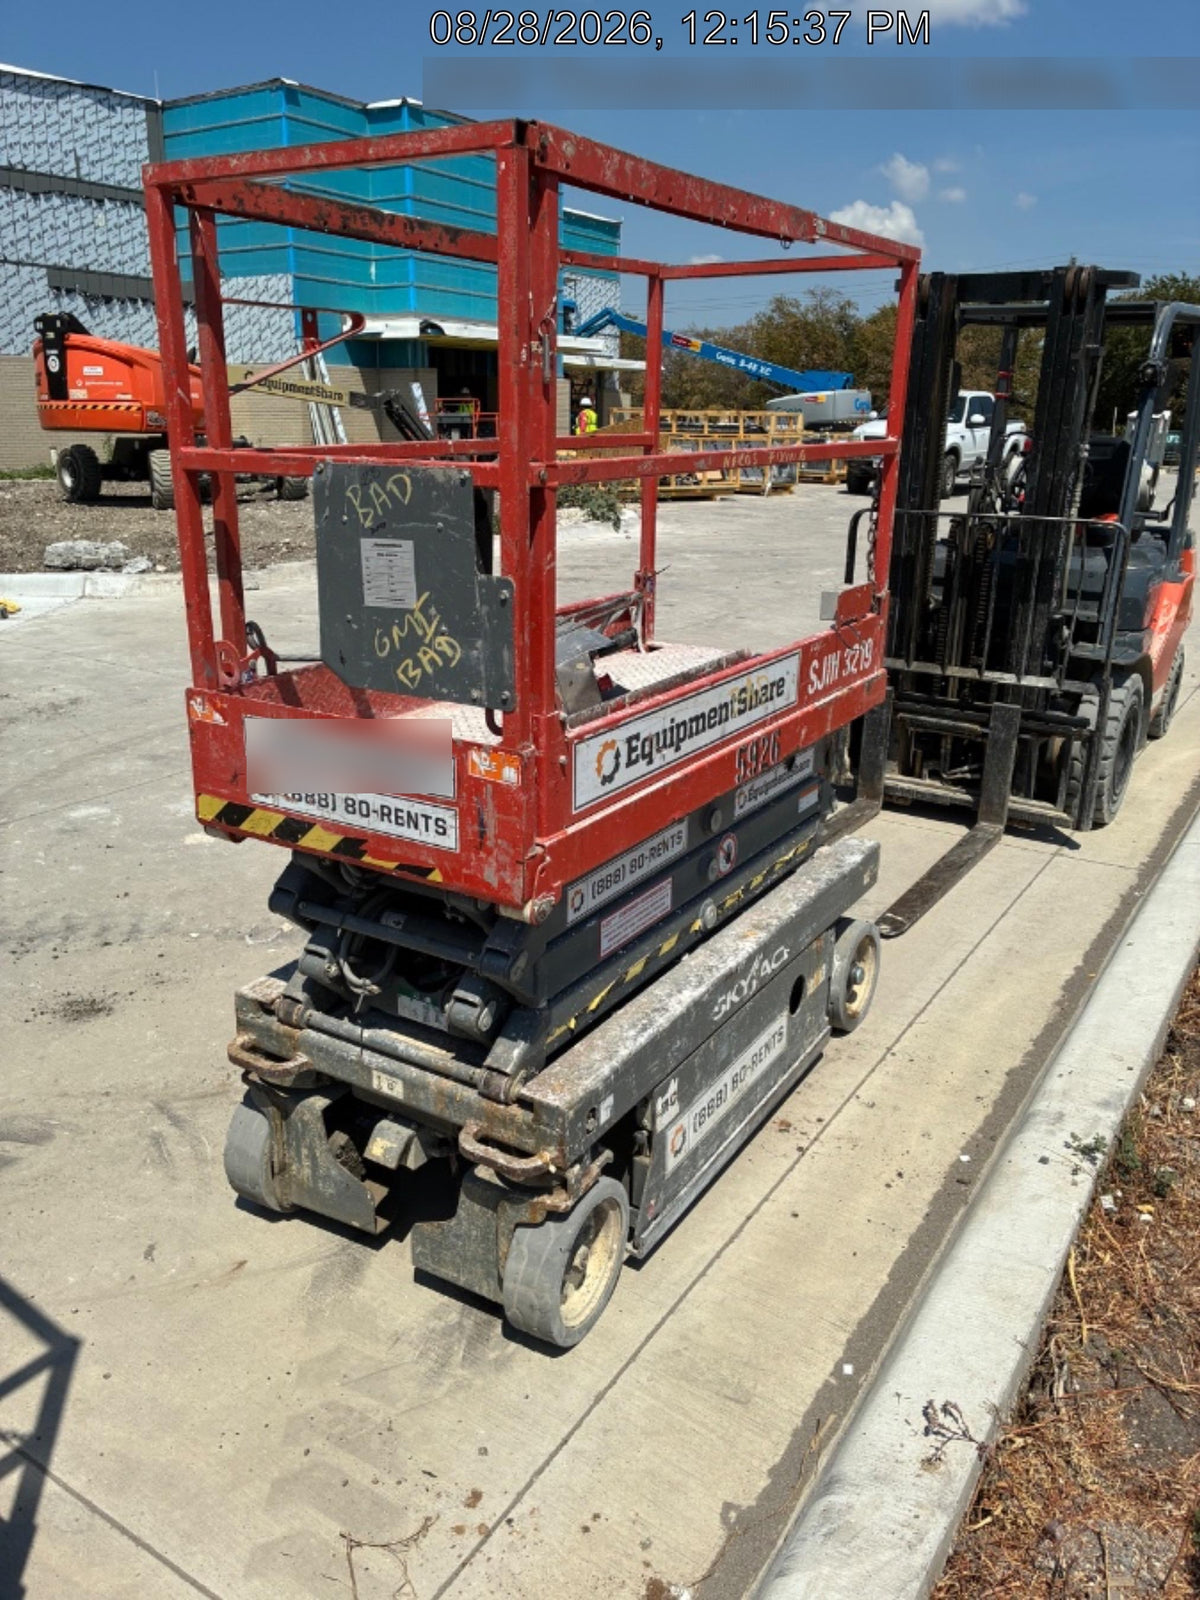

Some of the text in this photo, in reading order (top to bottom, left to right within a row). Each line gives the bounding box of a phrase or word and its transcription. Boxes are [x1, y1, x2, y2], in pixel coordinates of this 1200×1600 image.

[346, 473, 412, 528] BAD
[396, 635, 462, 689] BAD
[625, 676, 785, 770] EquipmentShare
[344, 797, 447, 836] 80-RENTS
[591, 829, 684, 900] (888) 80-RENTS
[692, 1024, 785, 1134] (888) 80-RENTS
